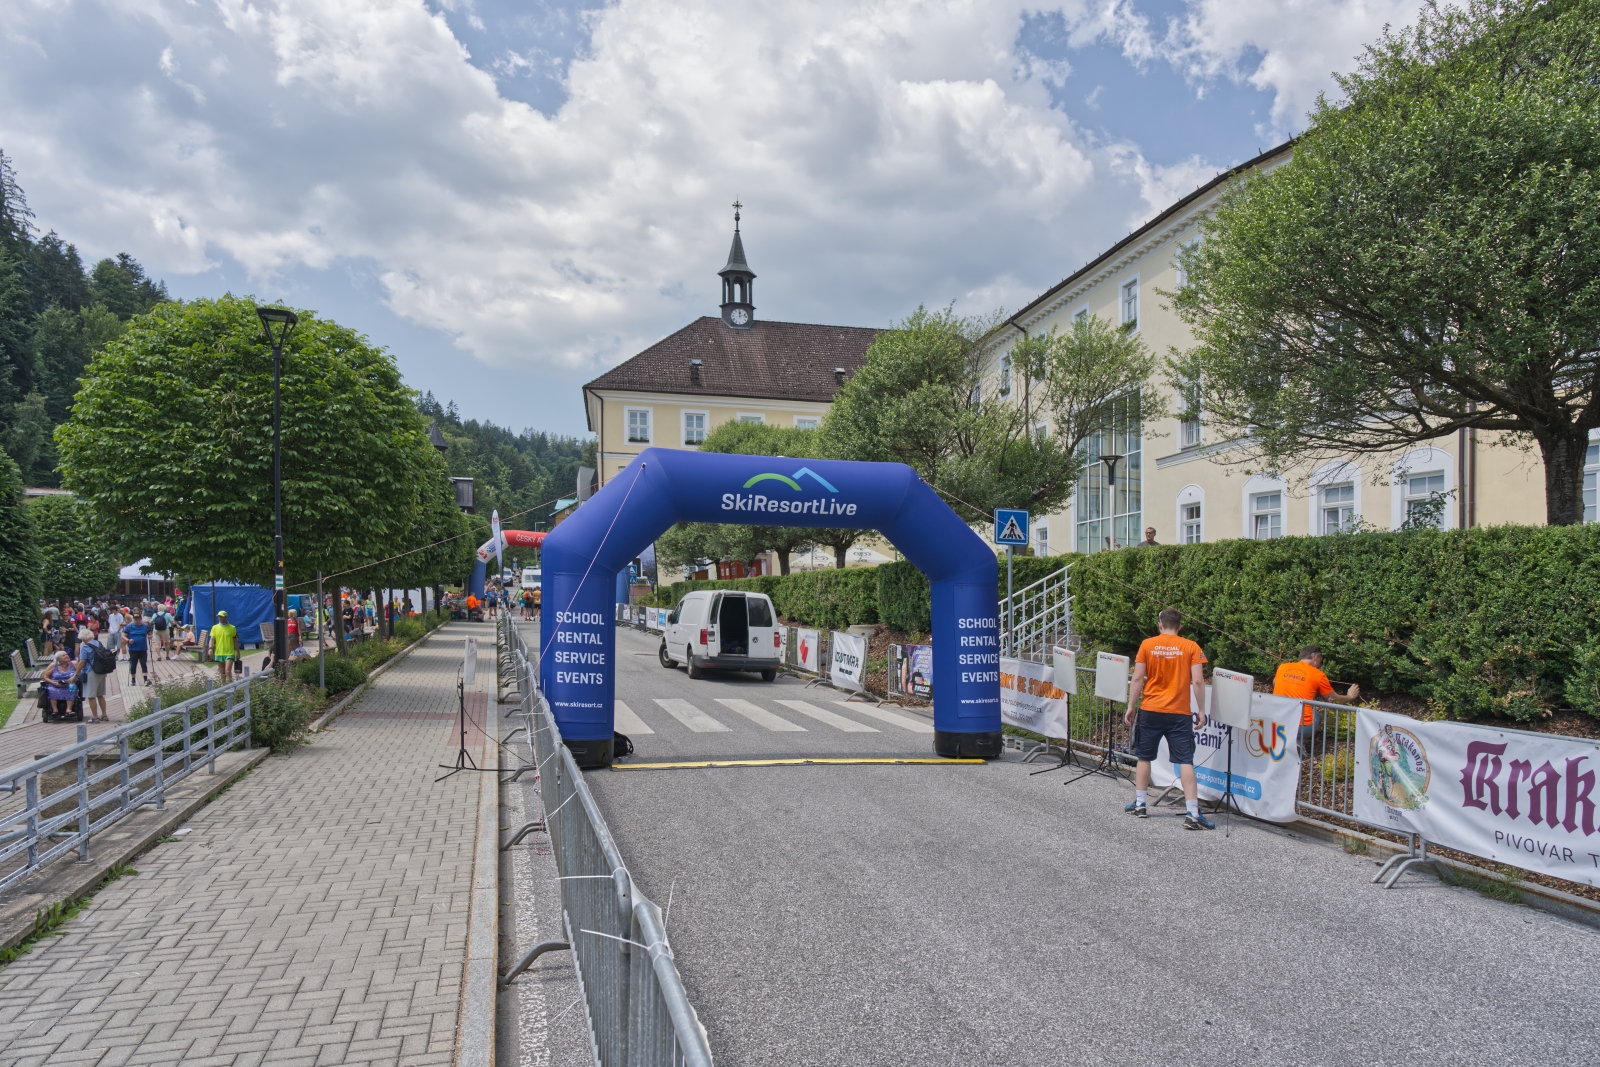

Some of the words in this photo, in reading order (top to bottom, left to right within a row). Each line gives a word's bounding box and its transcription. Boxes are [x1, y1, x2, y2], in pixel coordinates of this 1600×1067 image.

[721, 493, 858, 516] SkiResortLive
[555, 611, 605, 625] SCHOOL
[958, 617, 997, 629] SCHOOL
[557, 631, 603, 645] RENTAL
[960, 635, 997, 647] RENTAL
[554, 651, 605, 665] SERVICE
[958, 653, 999, 665] SERVICE
[556, 671, 603, 685] EVENTS
[961, 671, 998, 683] EVENTS
[1017, 675, 1027, 693] SE
[1494, 829, 1576, 864] PIVOVAR
